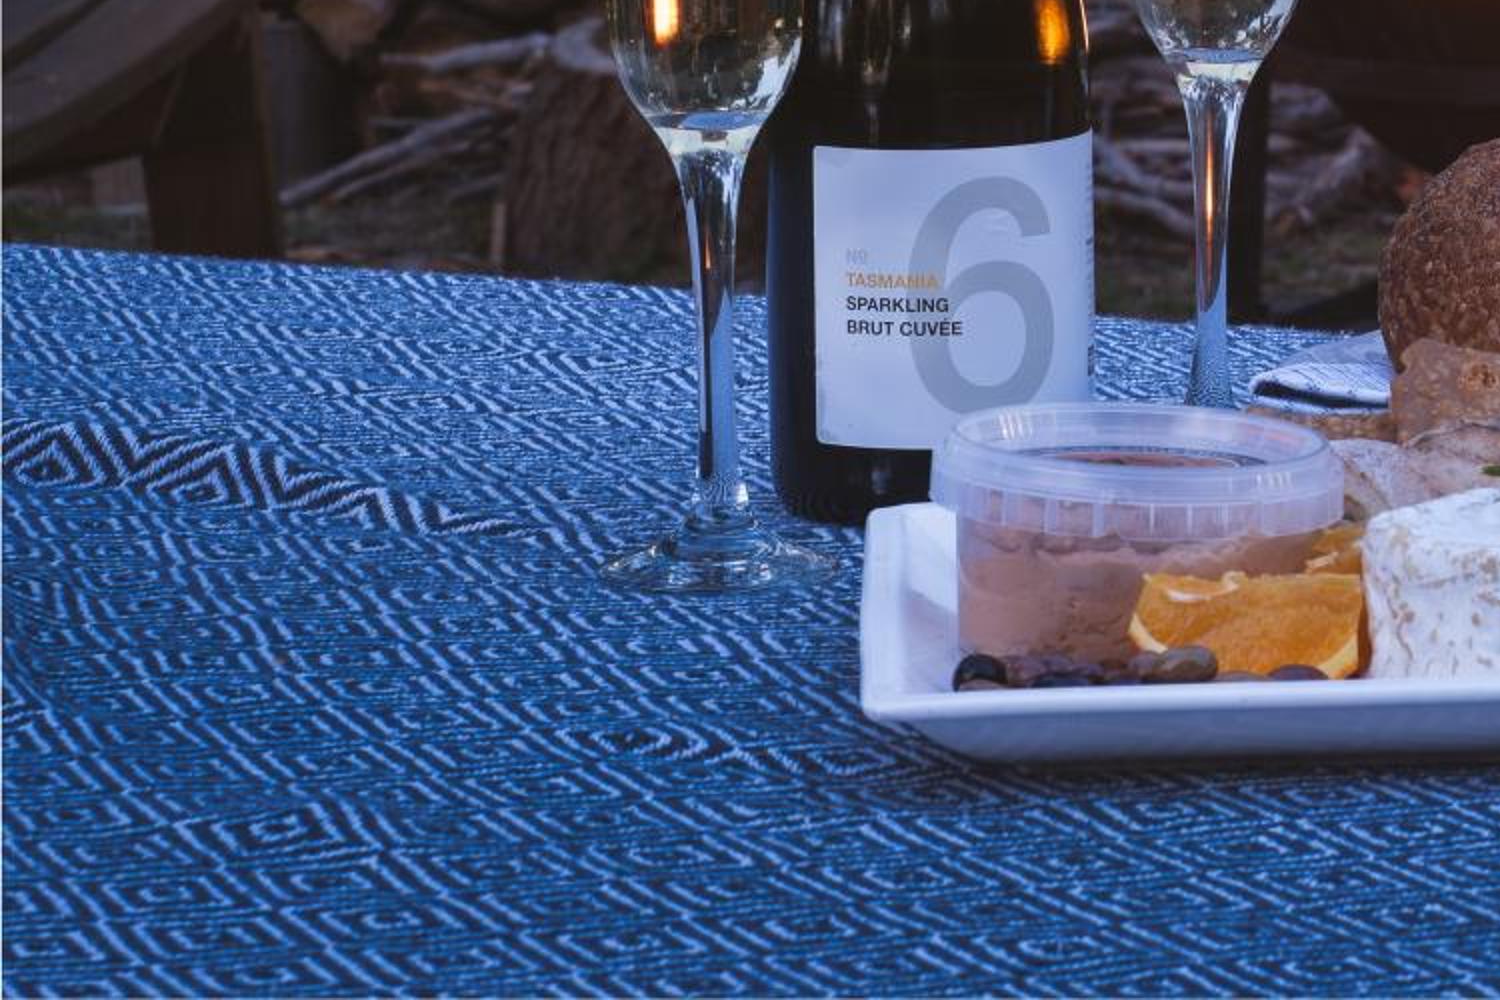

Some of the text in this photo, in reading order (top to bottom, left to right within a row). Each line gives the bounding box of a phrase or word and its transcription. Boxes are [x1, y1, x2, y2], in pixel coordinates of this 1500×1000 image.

[846, 272, 939, 290] TASMANIA
[846, 295, 950, 313] SPARKLING
[907, 175, 1055, 414] 6
[846, 316, 964, 337] BRUT CUVÉE
